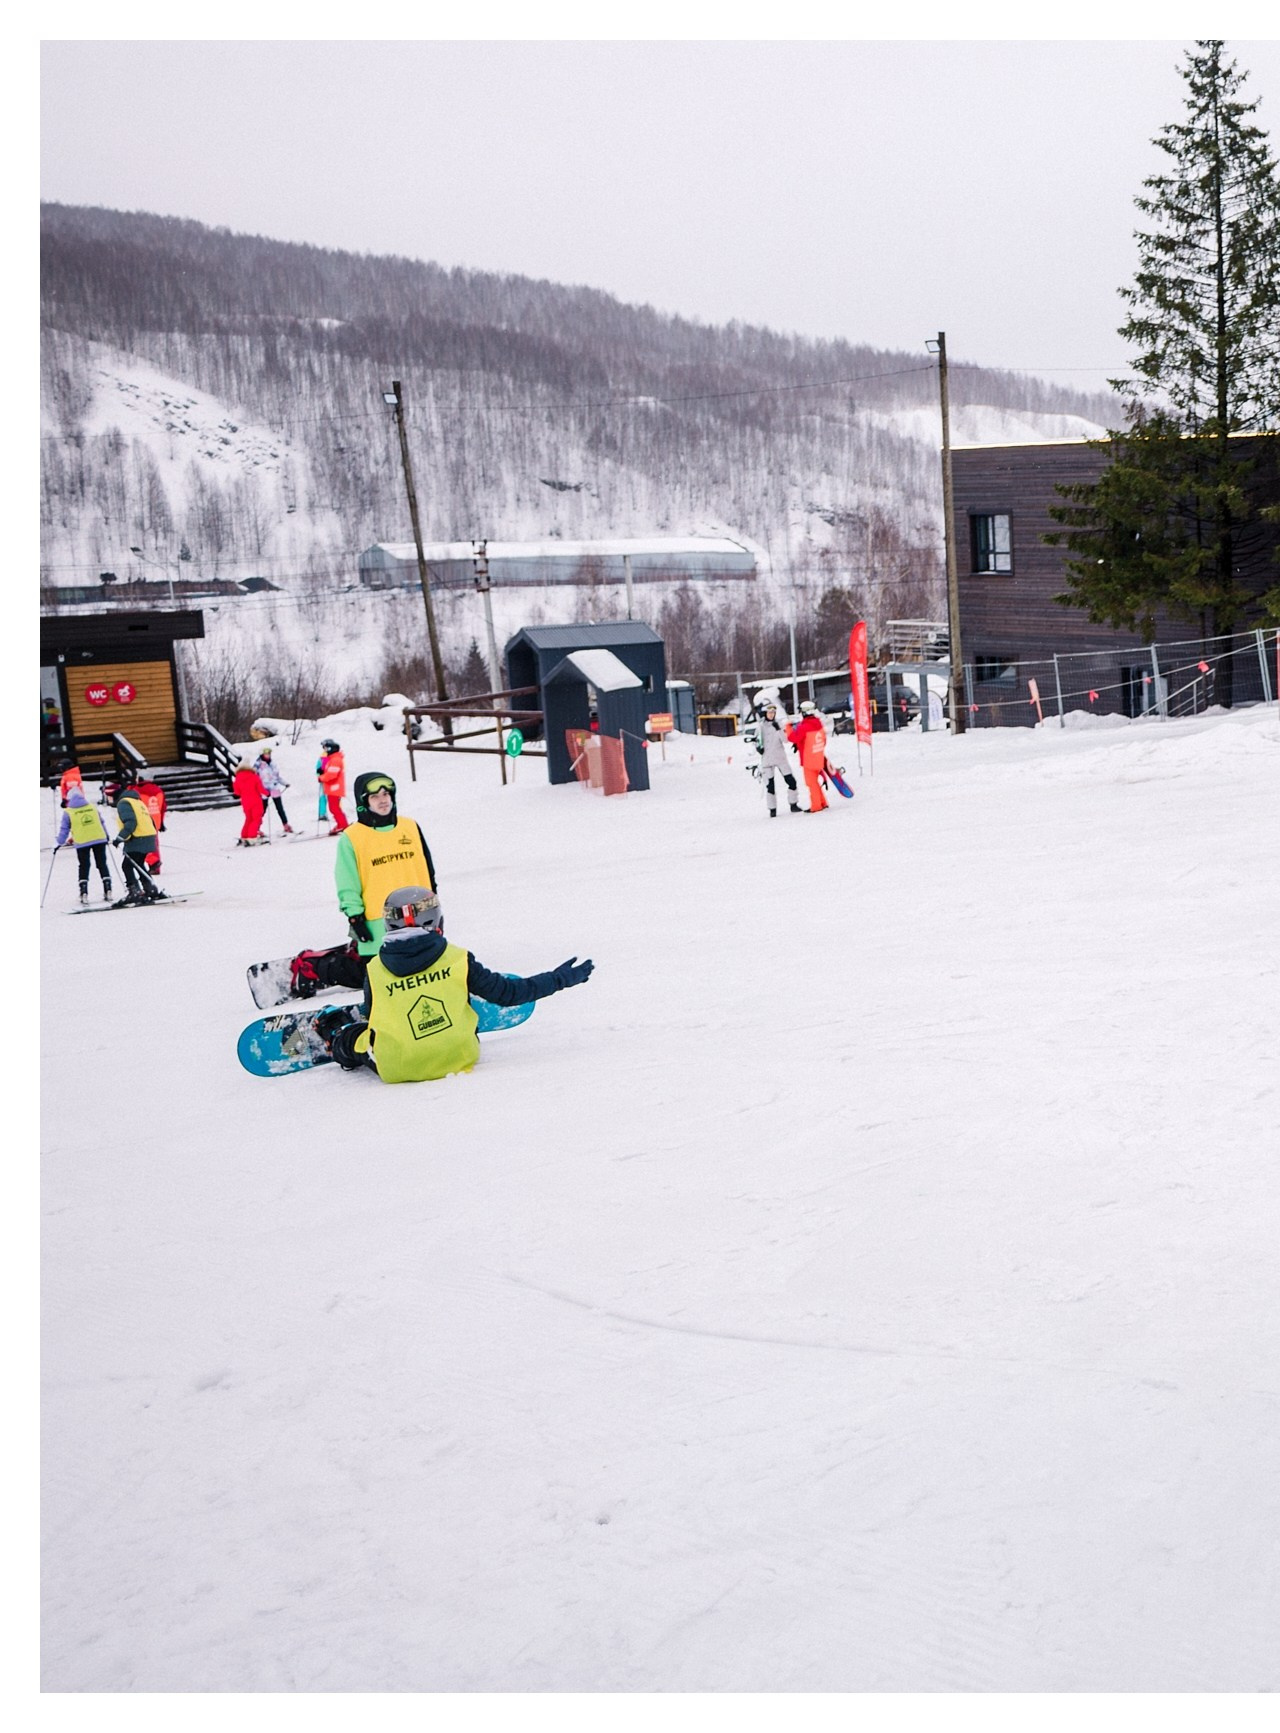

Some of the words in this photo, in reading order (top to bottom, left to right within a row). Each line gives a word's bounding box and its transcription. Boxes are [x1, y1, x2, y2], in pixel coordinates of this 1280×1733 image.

[89, 689, 108, 700] WC
[511, 737, 517, 752] 1
[385, 966, 451, 997] УЧЕНИК
